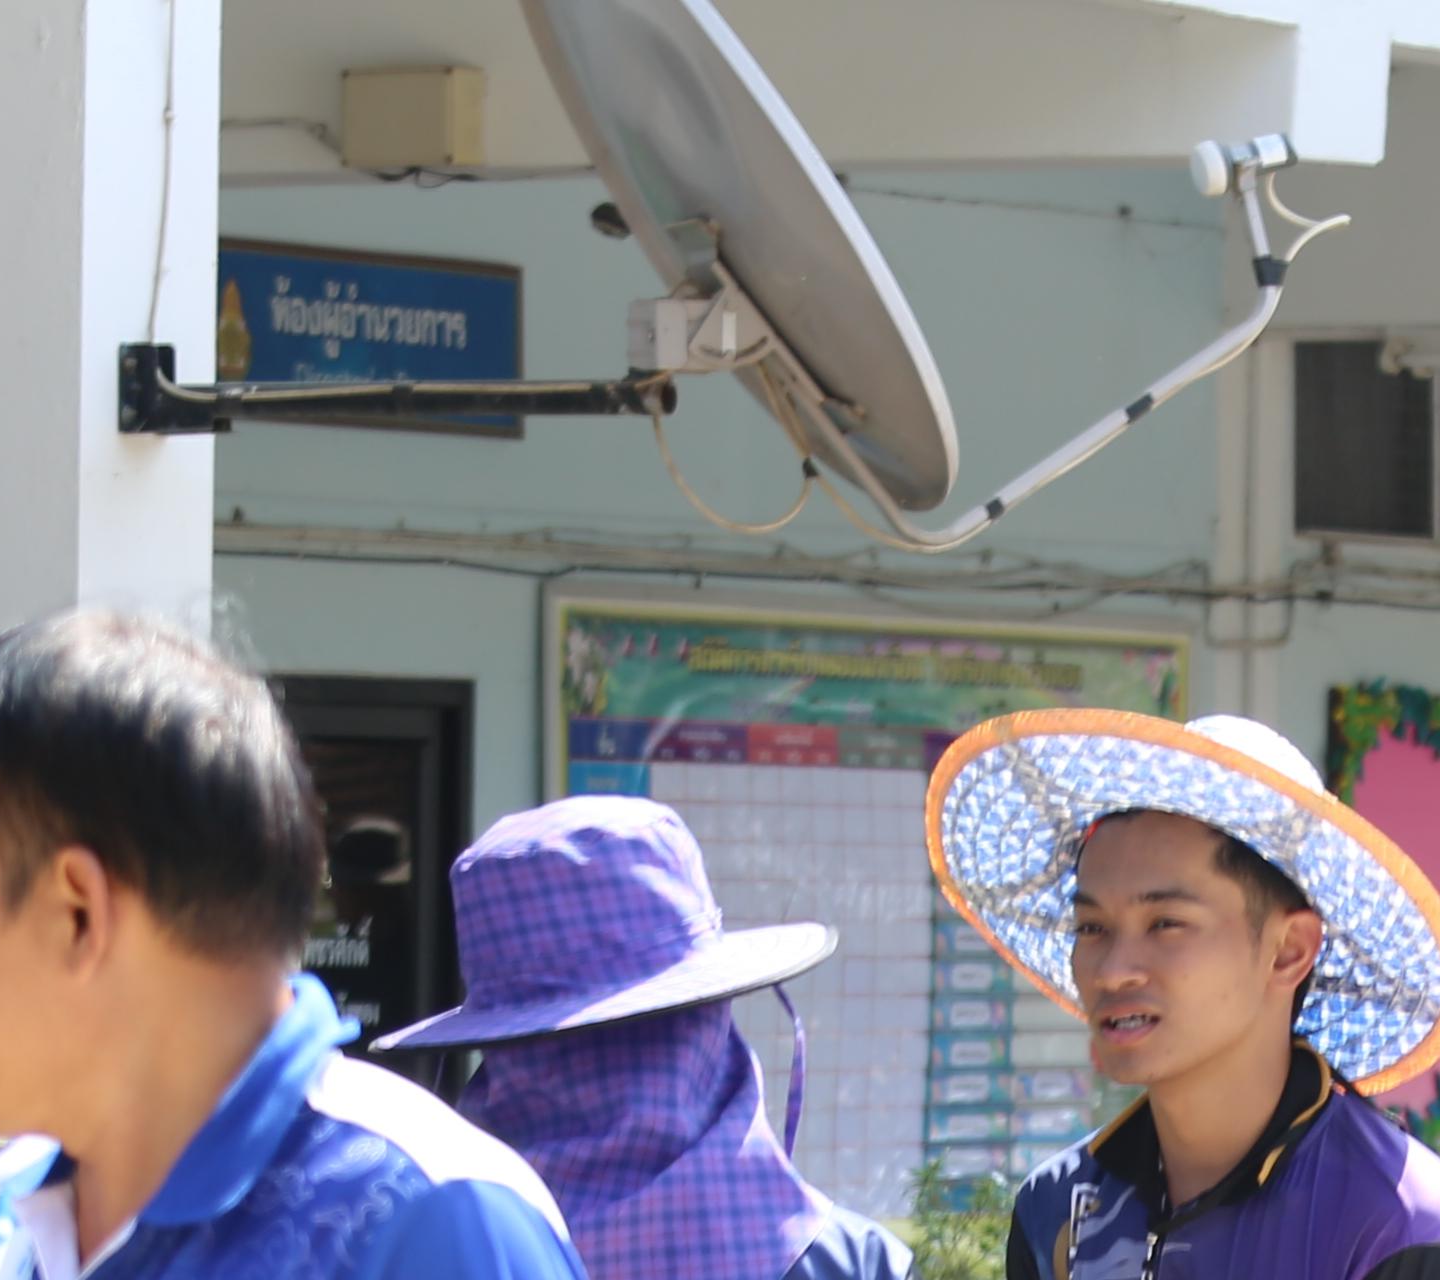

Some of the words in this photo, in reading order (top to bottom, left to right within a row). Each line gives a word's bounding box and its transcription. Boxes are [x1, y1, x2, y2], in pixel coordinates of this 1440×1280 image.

[271, 274, 467, 359] ห้องผู้อำนวยการ
